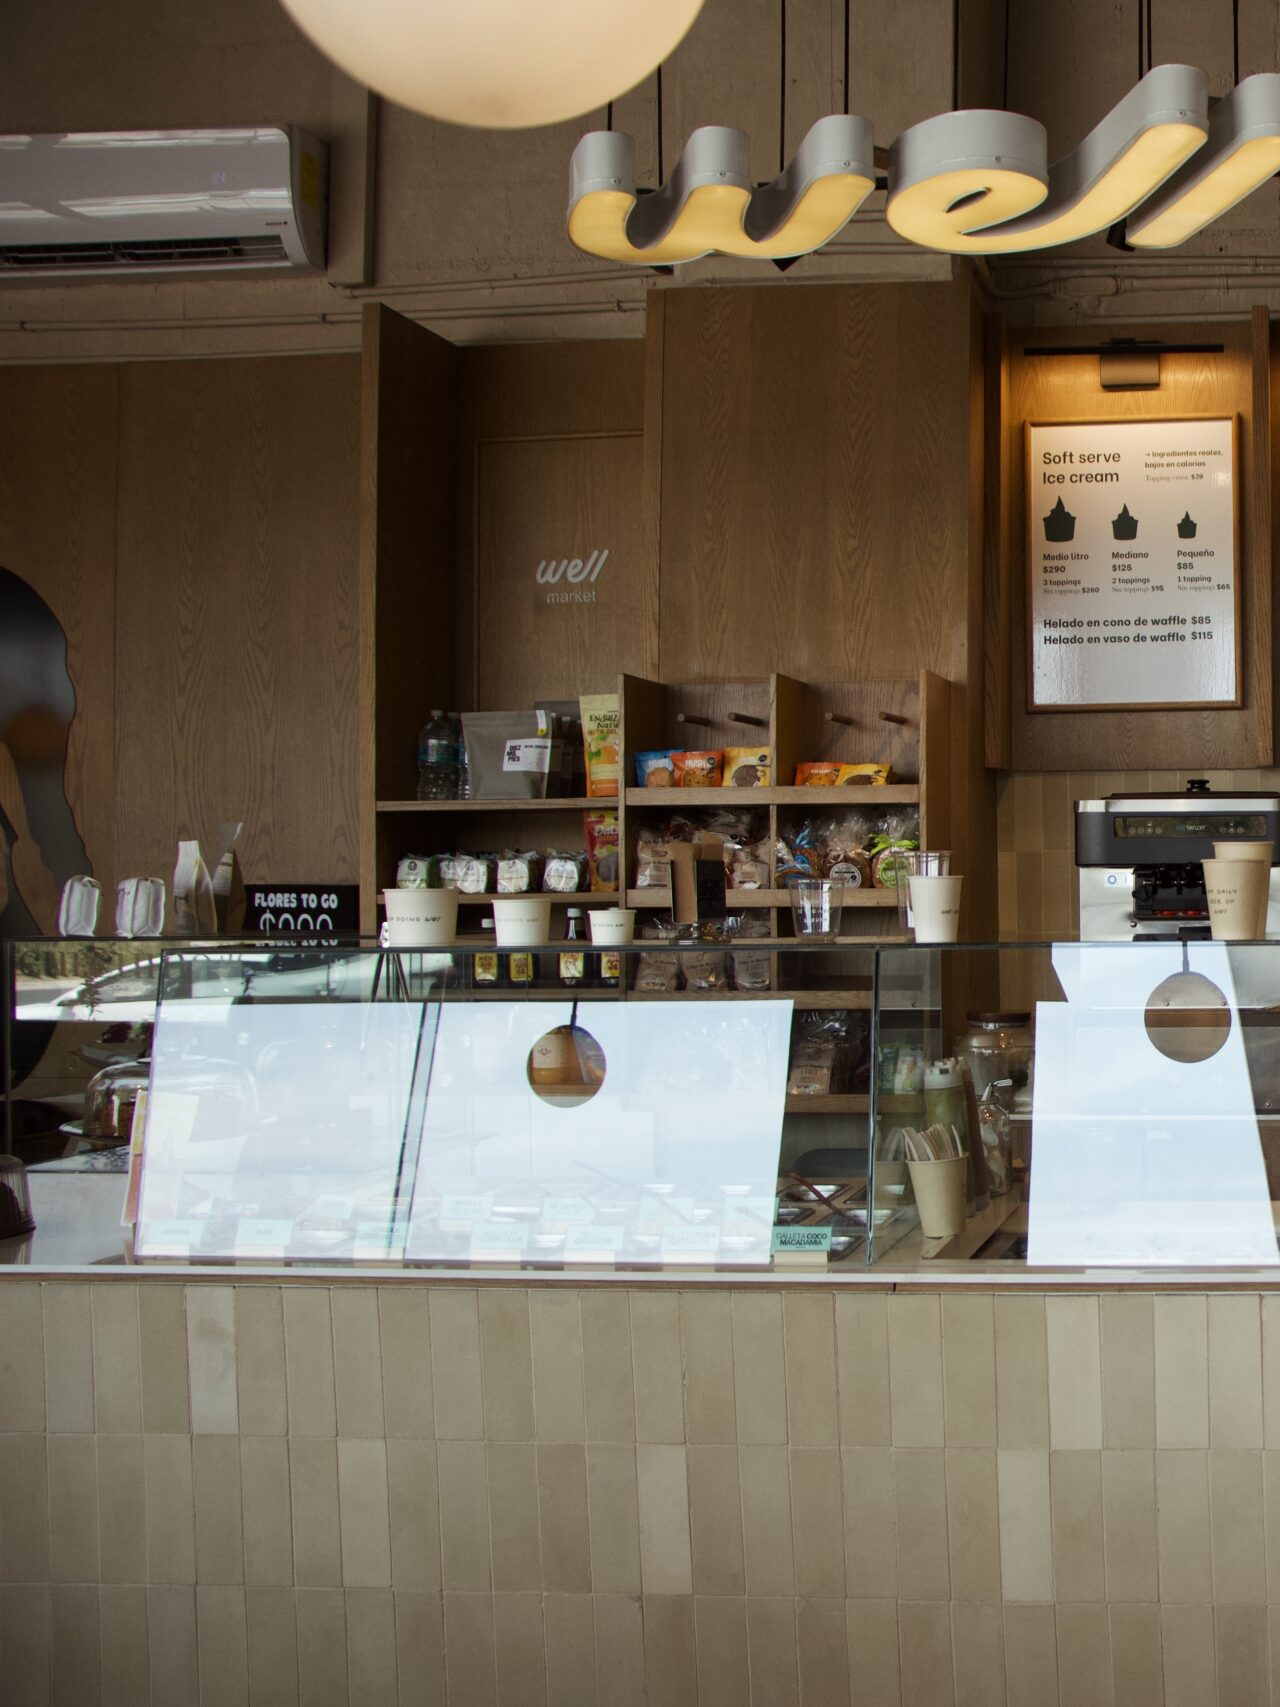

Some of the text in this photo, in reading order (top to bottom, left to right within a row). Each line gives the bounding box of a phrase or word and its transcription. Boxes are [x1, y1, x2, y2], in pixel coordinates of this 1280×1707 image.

[1042, 451, 1121, 465] Soft serve
[1152, 450, 1197, 458] Ingredientes
[1043, 470, 1120, 484] Ice cream
[1112, 551, 1149, 559] Mediano
[1177, 549, 1215, 558] Pequeño
[535, 548, 611, 585] well
[1042, 565, 1066, 574] $290
[1112, 564, 1132, 572] $125
[1177, 562, 1194, 570] $85
[1049, 578, 1081, 587] toppings
[1118, 577, 1150, 585] toppings
[1183, 575, 1212, 584] topping
[546, 590, 597, 604] market
[1043, 615, 1212, 629] Helado en cono de waffle $85
[1043, 634, 1085, 645] Helado
[1087, 636, 1100, 644] en
[1133, 633, 1148, 643] de
[1150, 631, 1186, 642] waffle
[1191, 631, 1213, 640] $115
[254, 892, 339, 910] FLORES TO GO
